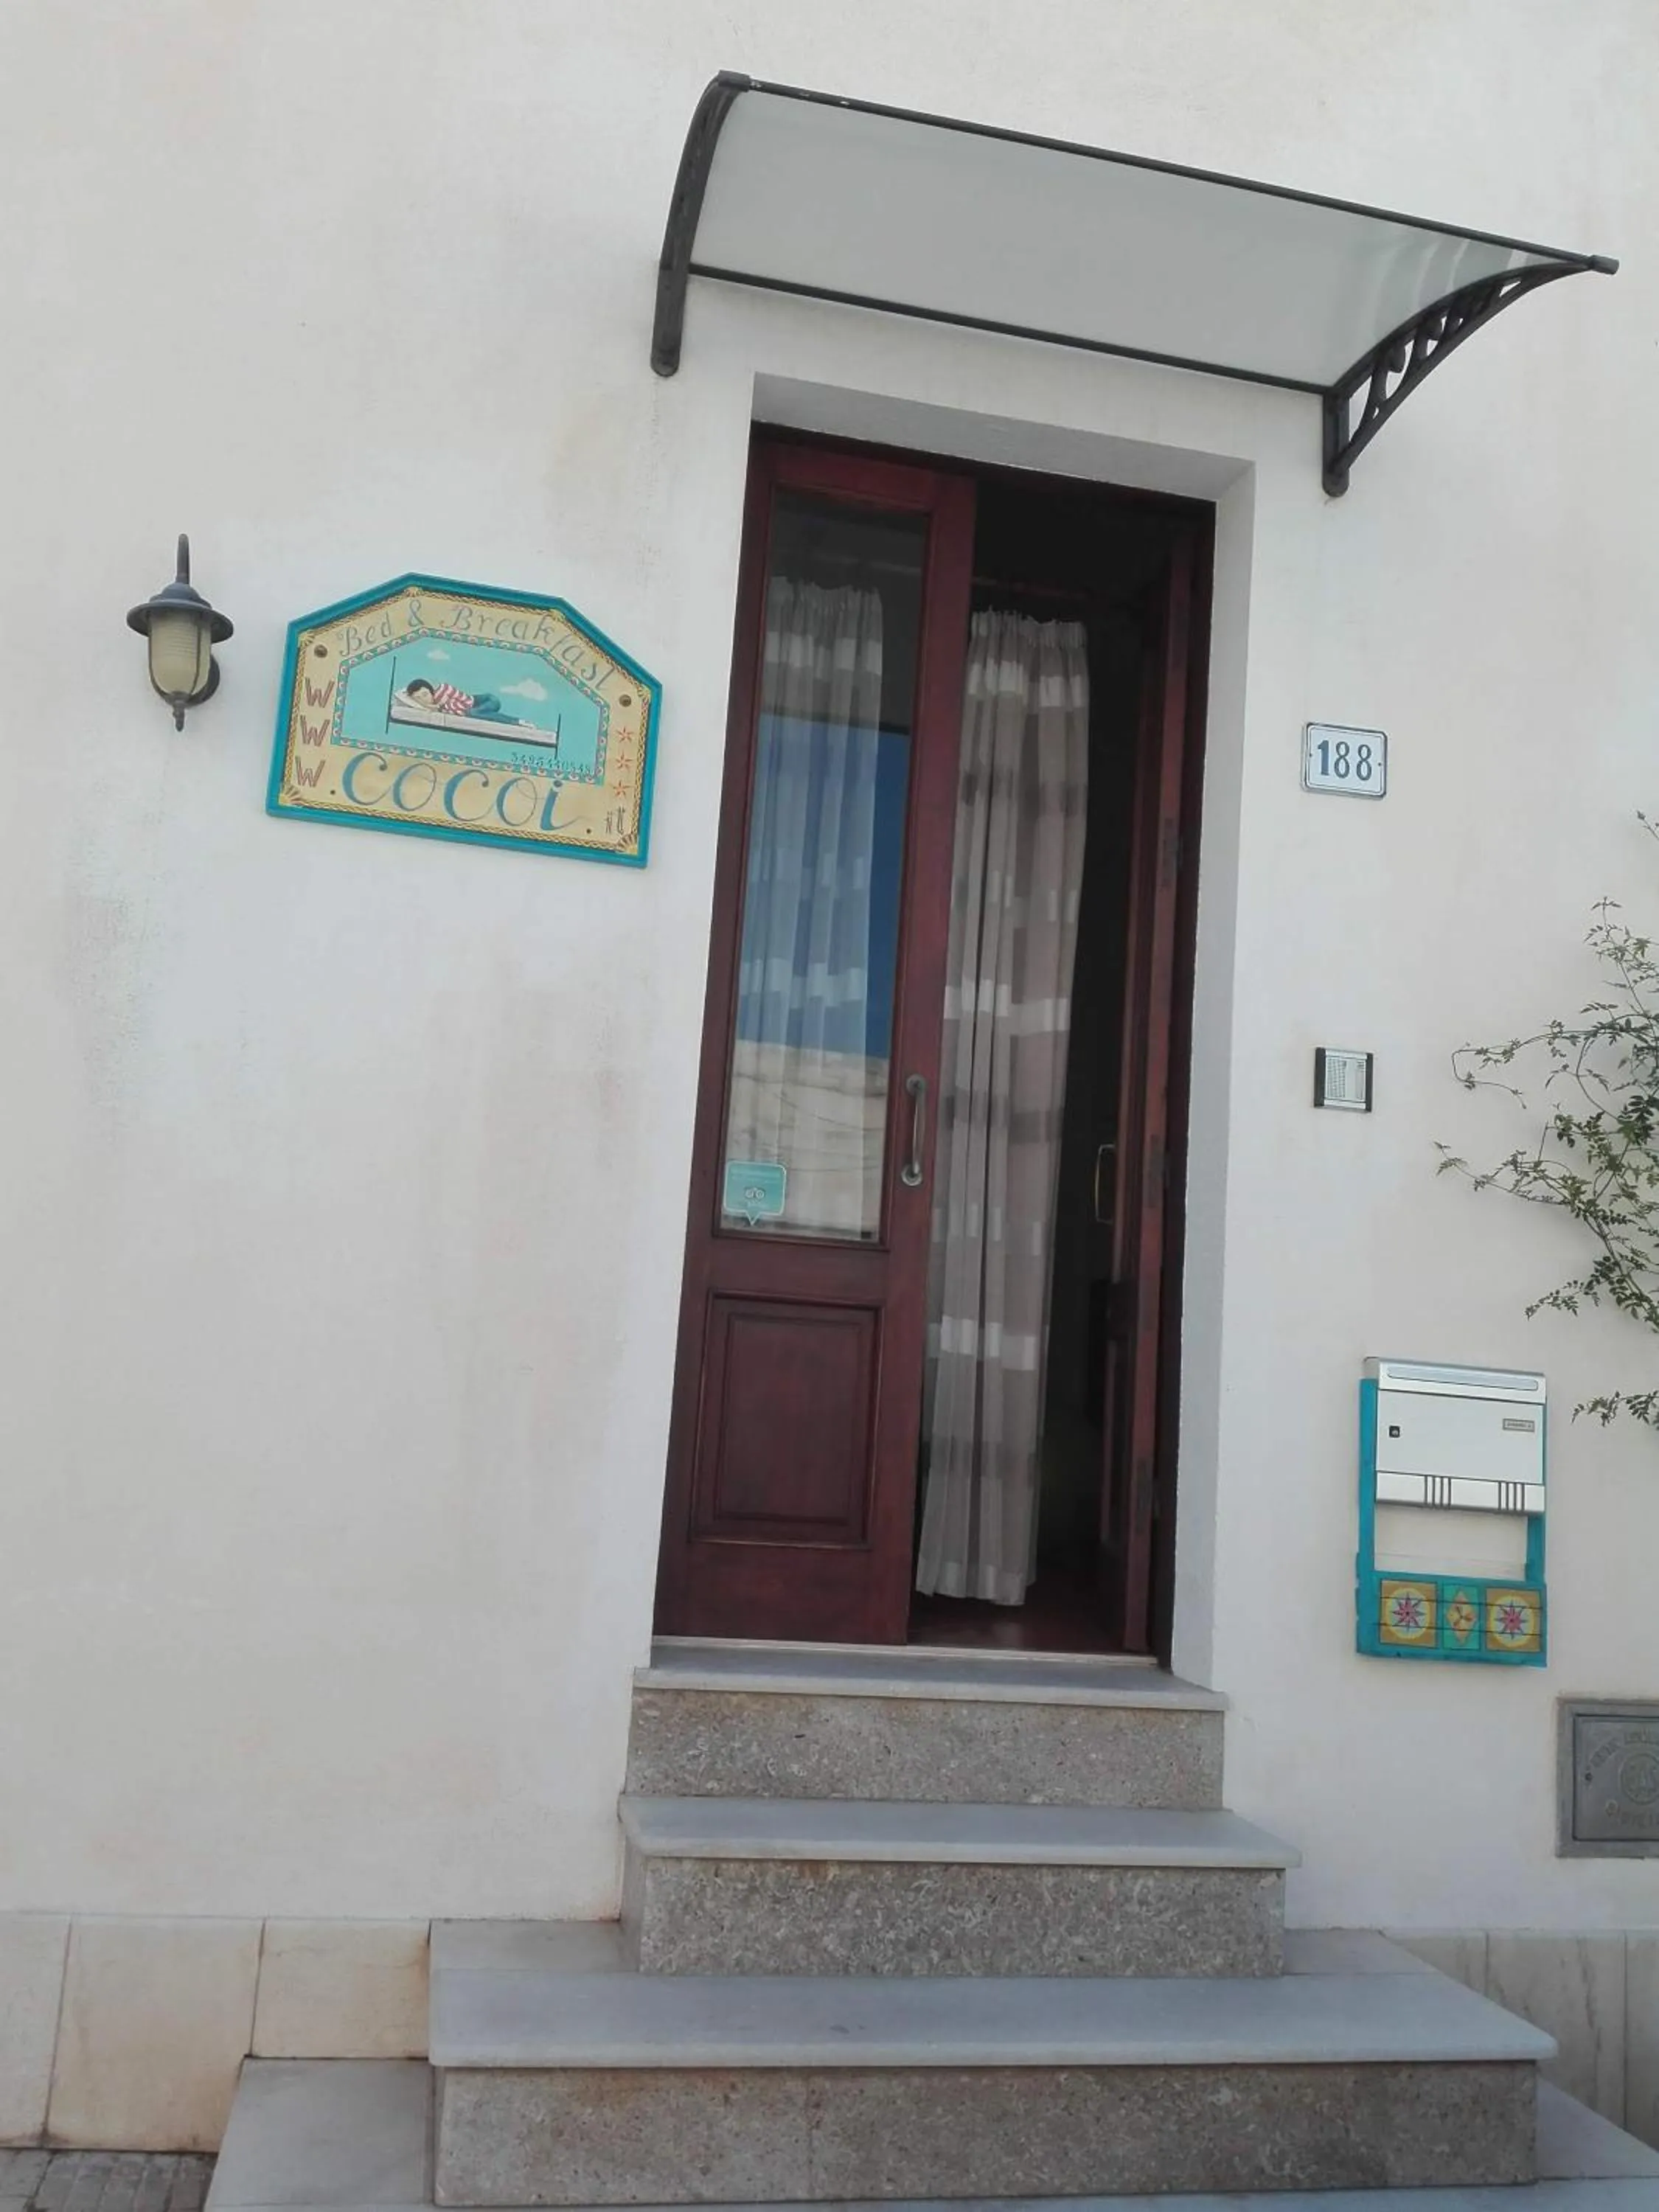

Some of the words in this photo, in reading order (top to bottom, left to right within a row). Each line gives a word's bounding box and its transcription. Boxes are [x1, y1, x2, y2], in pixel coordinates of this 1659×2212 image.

[339, 611, 394, 657] Bed
[407, 599, 426, 627] &
[440, 605, 616, 689] Breakfast
[1317, 740, 1373, 782] 188
